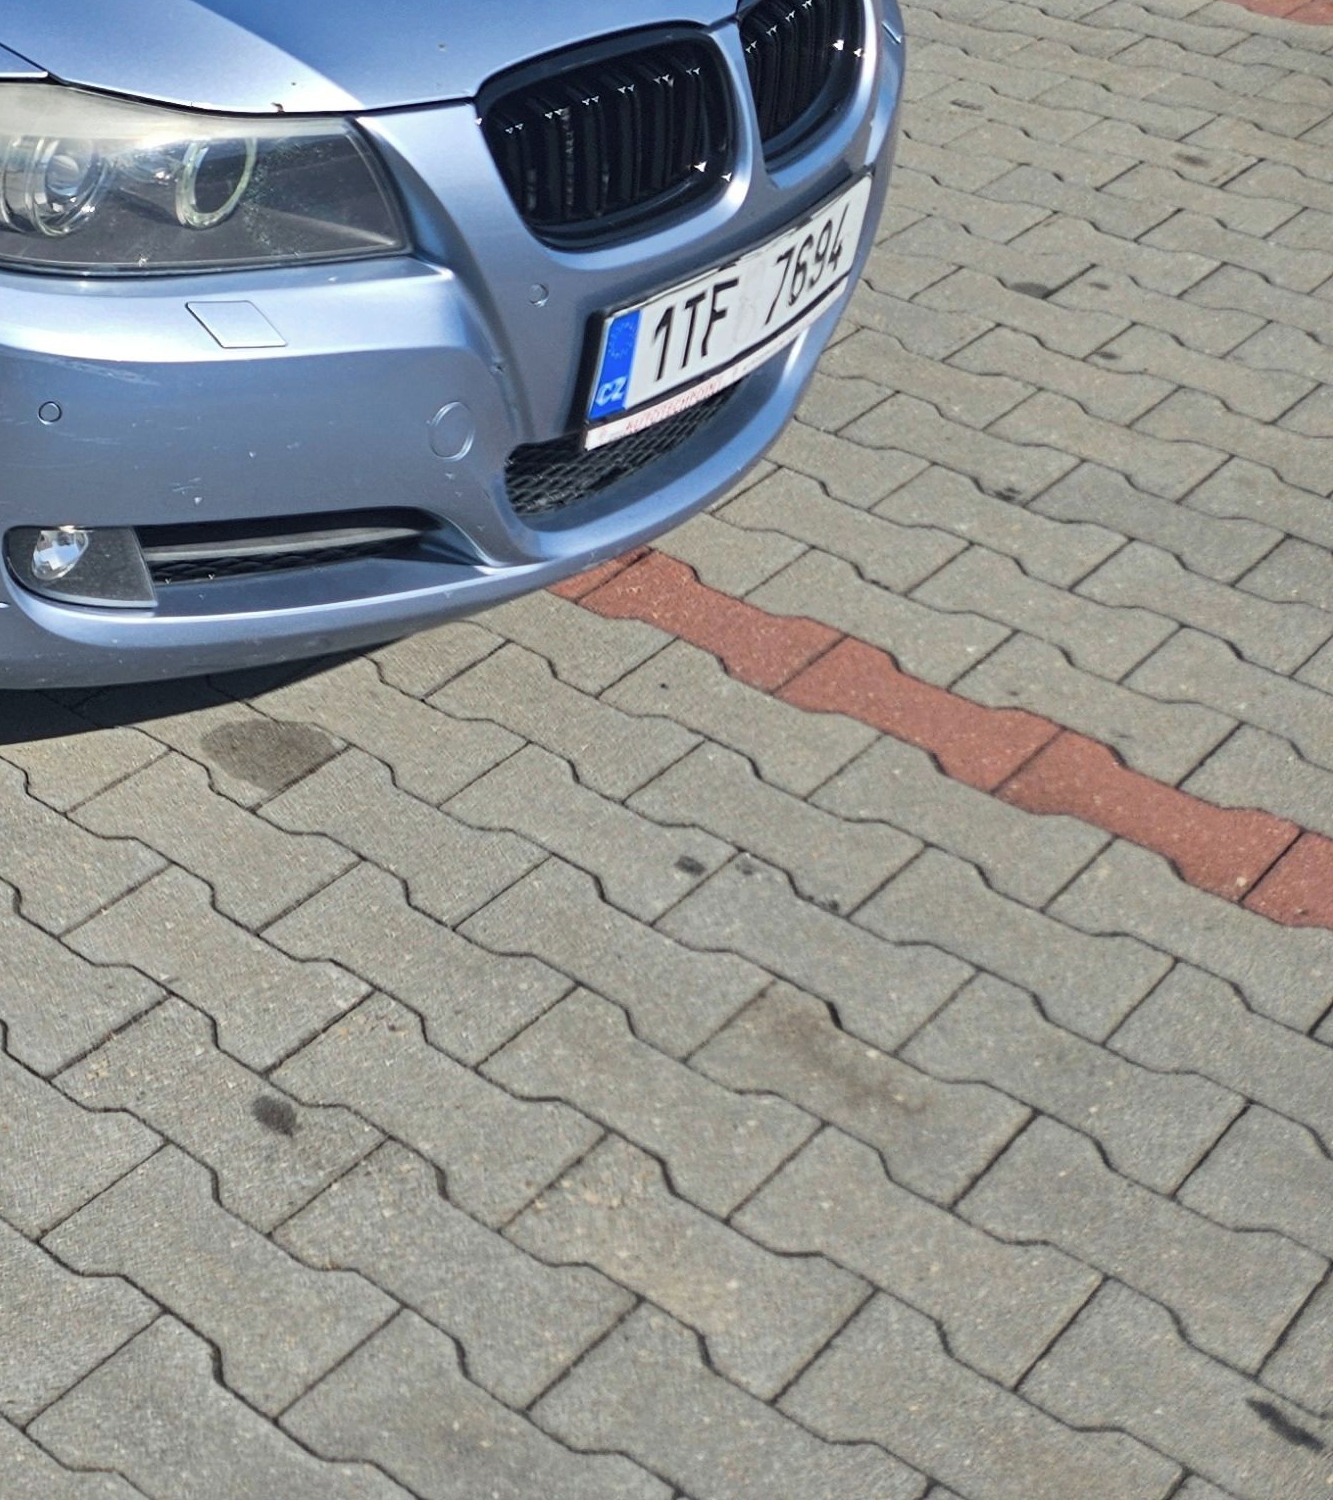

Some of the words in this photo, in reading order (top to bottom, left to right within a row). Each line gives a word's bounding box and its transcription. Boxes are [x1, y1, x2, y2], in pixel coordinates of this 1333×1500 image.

[653, 278, 739, 382] 1TF
[765, 203, 849, 326] 7694
[596, 376, 628, 406] CZ
